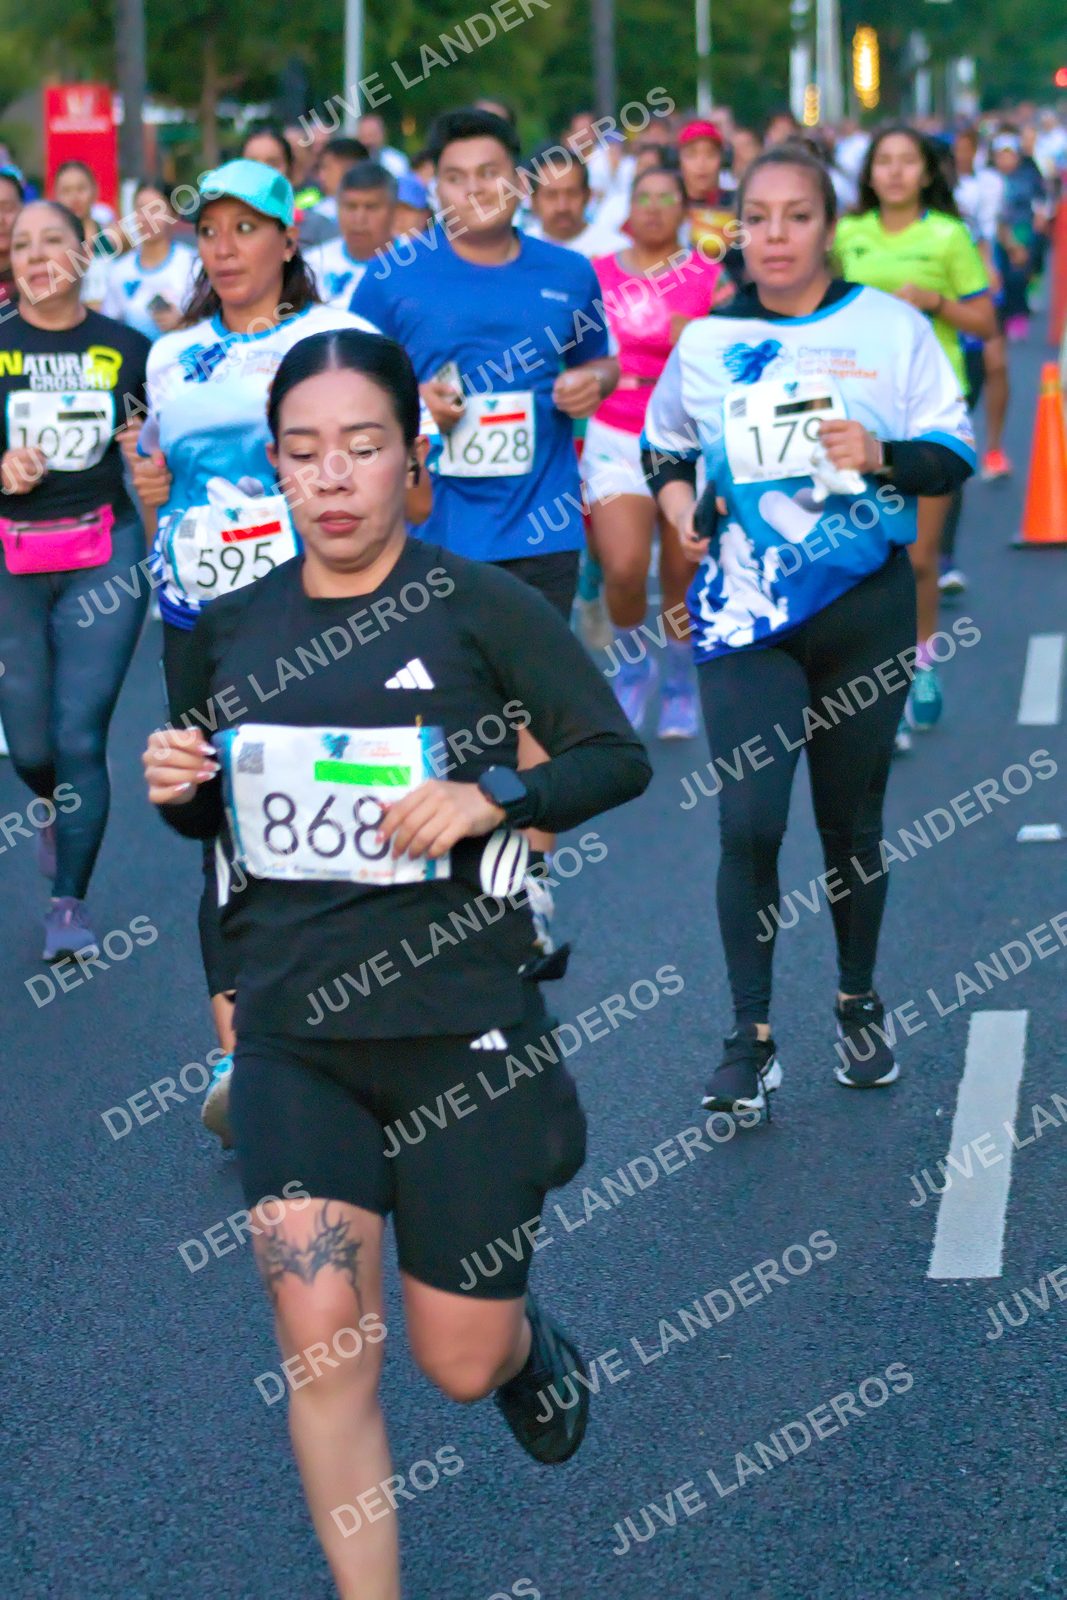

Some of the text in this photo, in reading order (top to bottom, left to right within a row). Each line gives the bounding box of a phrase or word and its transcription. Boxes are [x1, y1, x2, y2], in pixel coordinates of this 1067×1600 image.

[18, 426, 102, 459] 1021
[446, 428, 530, 465] 1628
[196, 542, 276, 589] 595
[263, 792, 391, 861] 868
